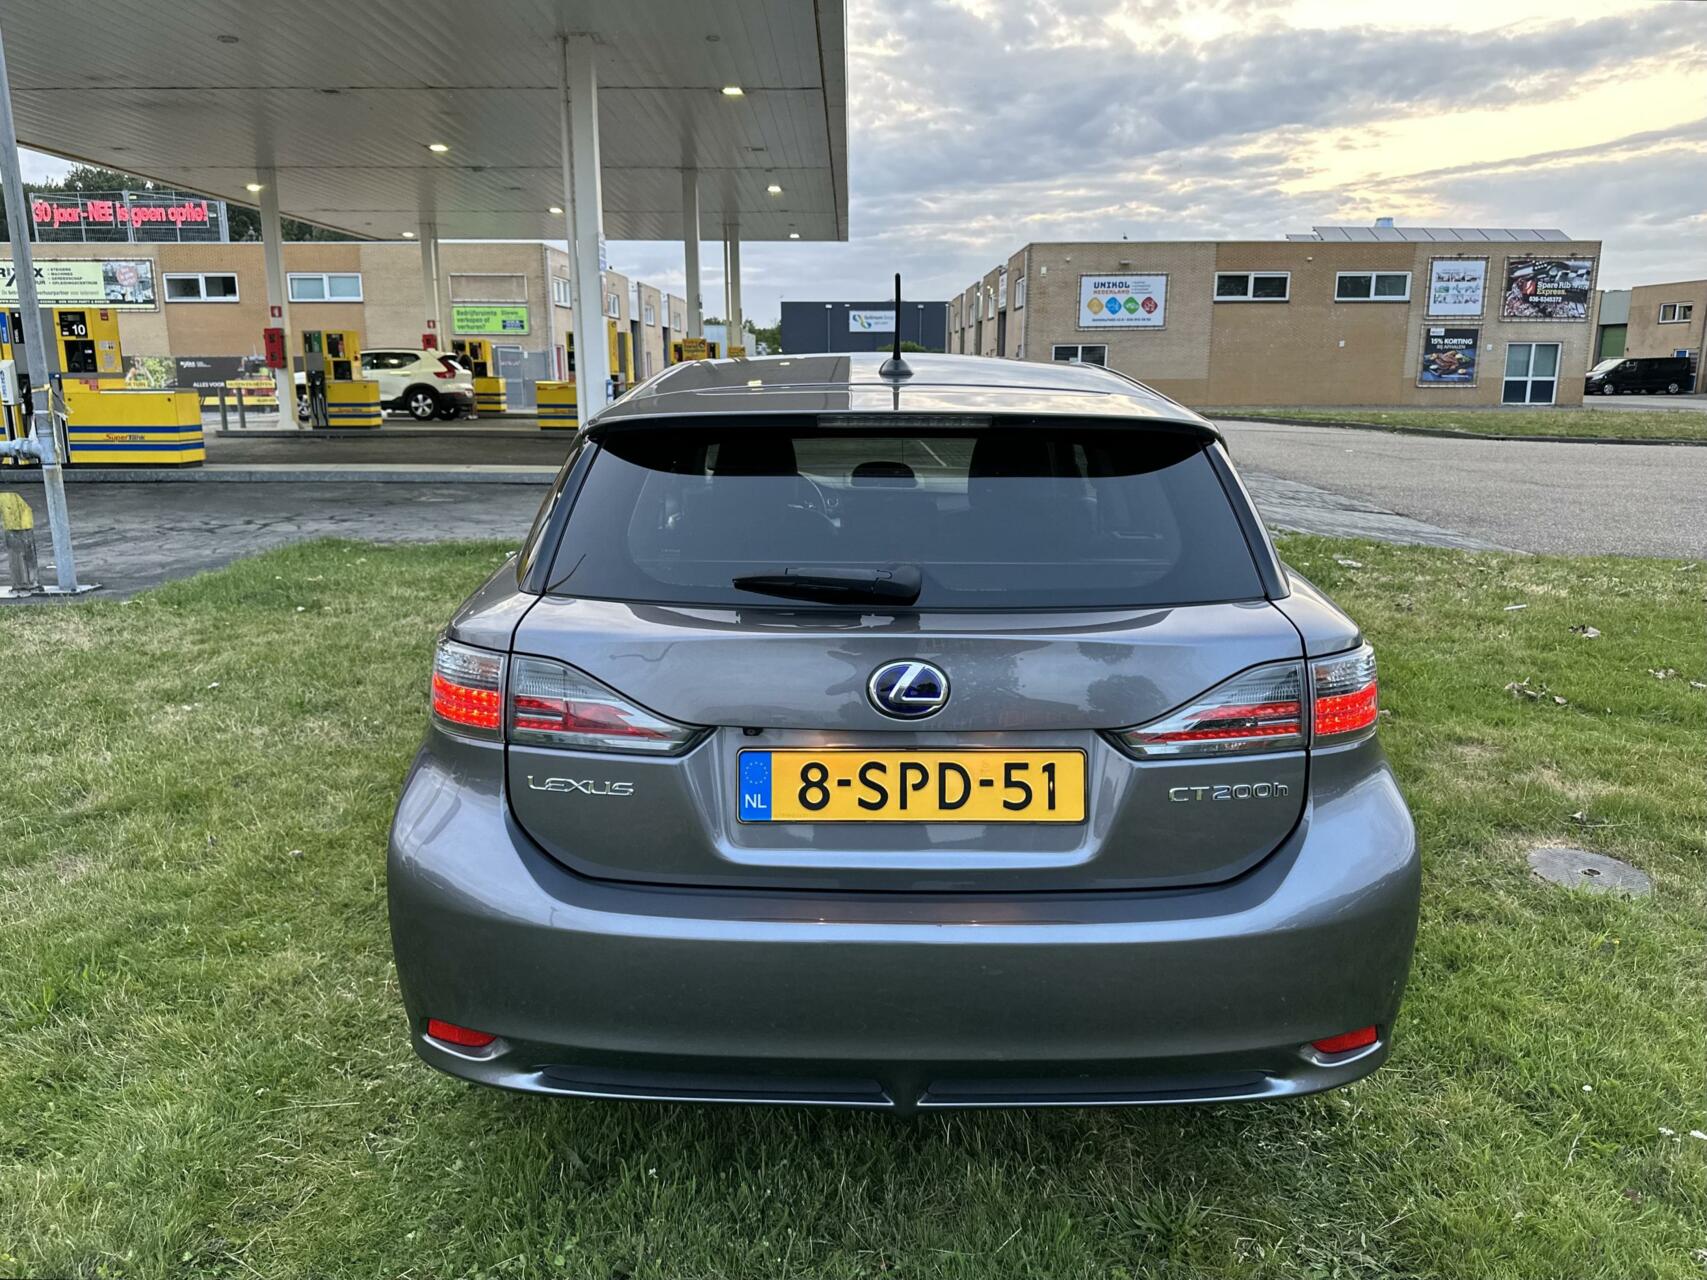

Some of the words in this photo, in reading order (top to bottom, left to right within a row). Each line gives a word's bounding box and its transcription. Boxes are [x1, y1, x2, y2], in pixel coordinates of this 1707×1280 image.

[131, 207, 166, 227] geen
[1537, 281, 1558, 289] Spare
[72, 324, 86, 335] 10
[527, 775, 634, 796] LEXUS
[797, 761, 1056, 811] 8-SPD-51
[1169, 782, 1289, 802] CT200h
[745, 795, 767, 809] NL
